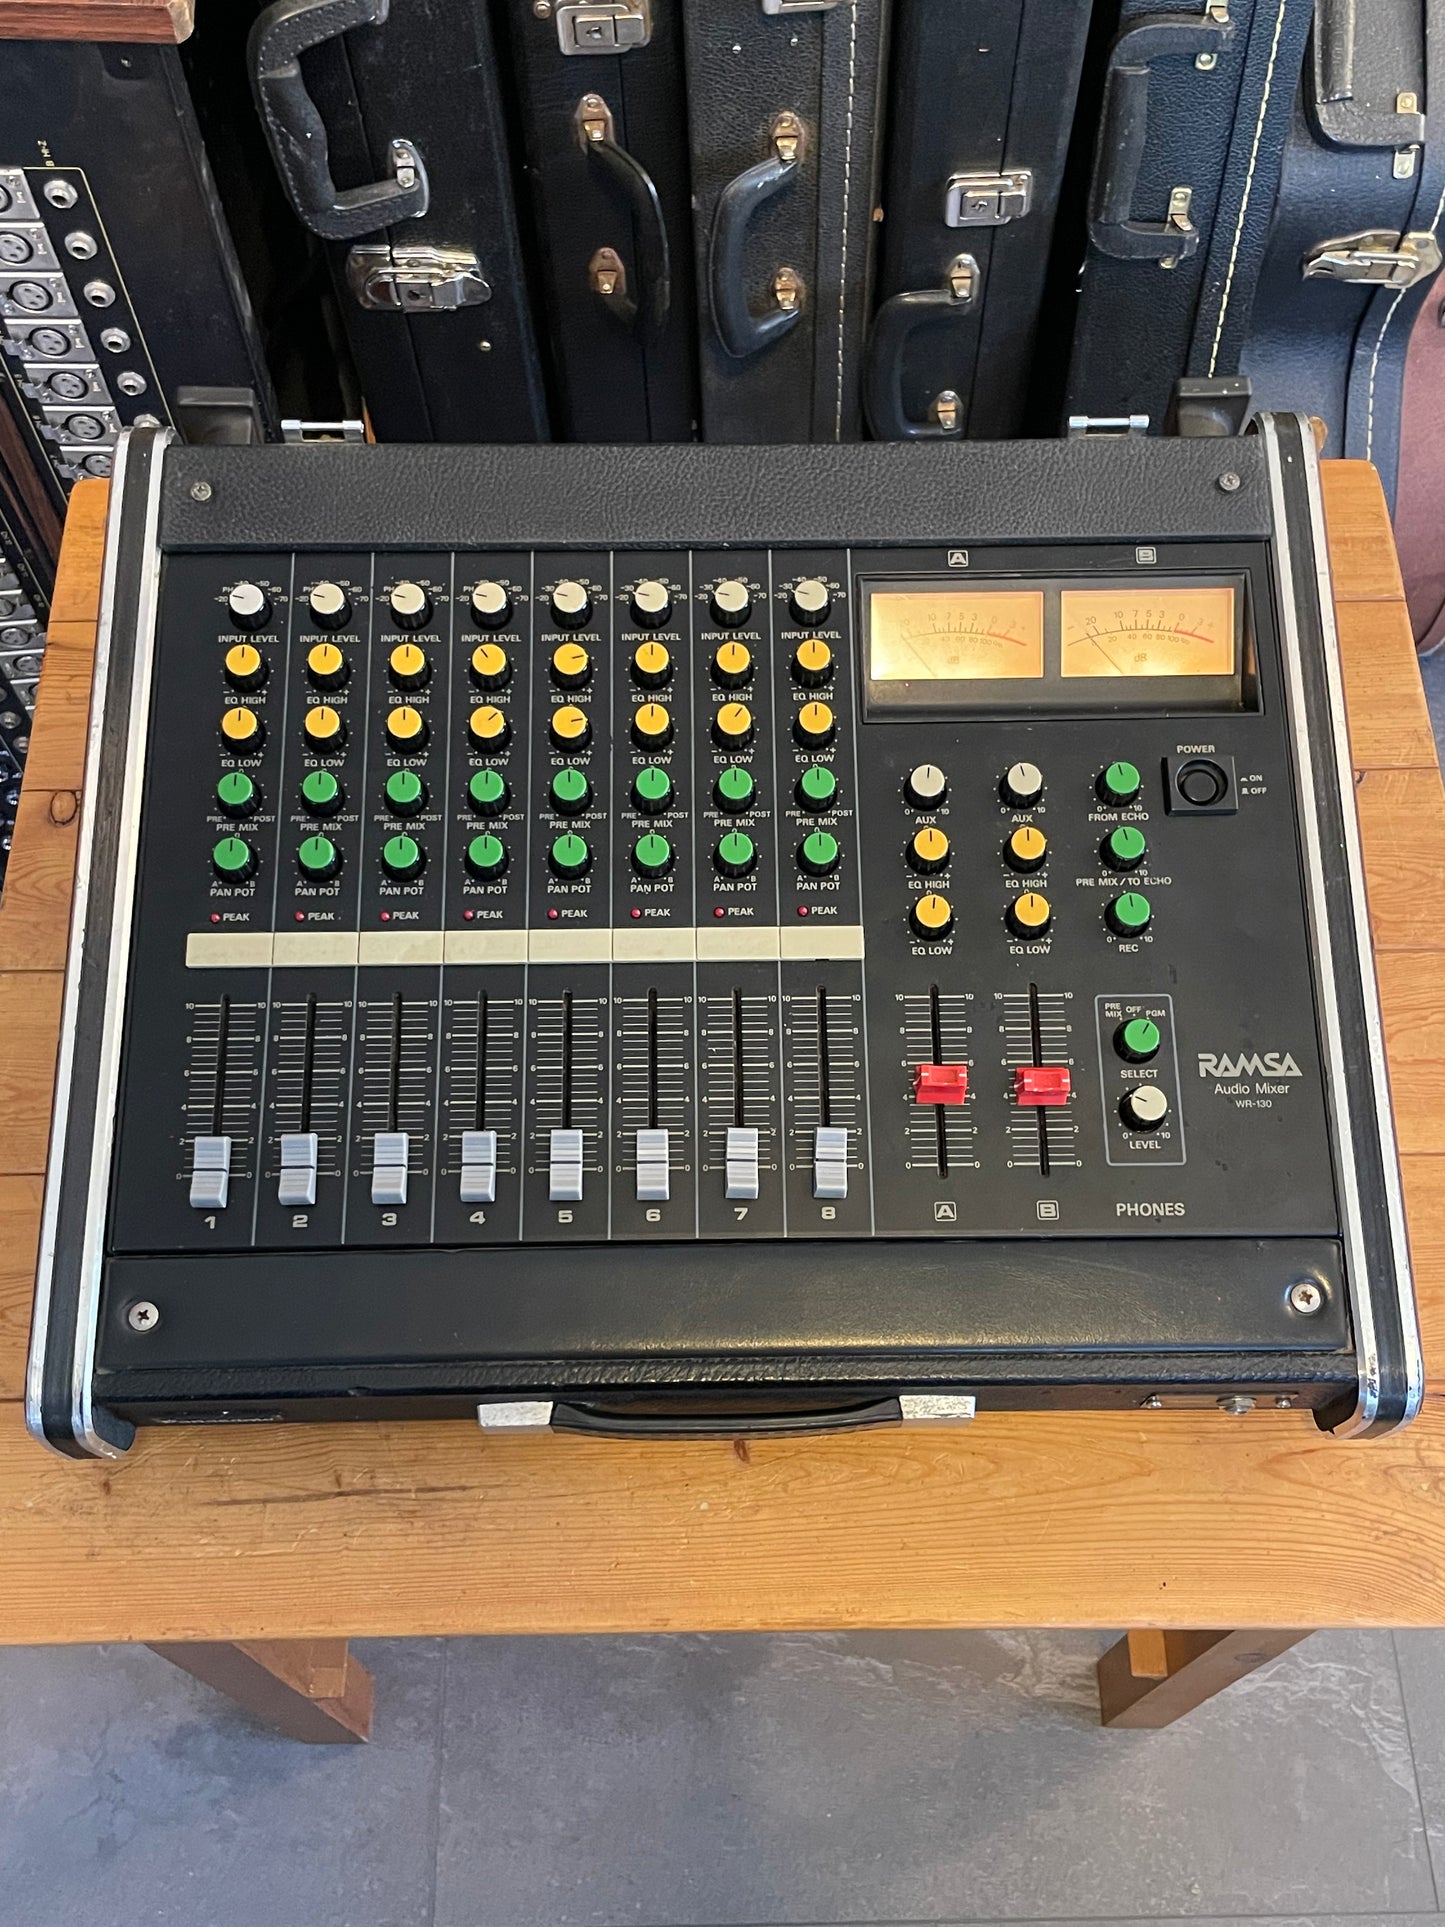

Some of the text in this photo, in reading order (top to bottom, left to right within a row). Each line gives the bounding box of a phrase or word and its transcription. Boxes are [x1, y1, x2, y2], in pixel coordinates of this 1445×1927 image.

[949, 551, 967, 566] A
[218, 635, 247, 643] INPUT
[493, 634, 521, 642] LEVEL
[622, 633, 681, 641] INPUT LEVEL
[701, 632, 761, 640] INPUT LEVEL
[813, 631, 841, 639] LEVEL
[307, 696, 347, 704] EQ HIGH
[389, 696, 429, 704] EQ HIGH
[551, 695, 564, 703] EQ
[809, 692, 833, 700] HIGH
[1177, 745, 1215, 753] POWER
[404, 758, 427, 766] LOW
[469, 758, 509, 766] EQ LOW
[567, 757, 590, 765] LOW
[648, 756, 672, 764] LOW
[730, 755, 753, 763] LOW
[795, 754, 834, 763] EQ LOW
[221, 759, 262, 767] EQ LOW
[304, 759, 344, 767] EQ LOW
[915, 816, 936, 824] AUX
[1011, 814, 1033, 822] AUX
[1088, 812, 1149, 821] FROM ECHO
[467, 822, 485, 830] PRE
[550, 821, 568, 829] PRE
[632, 820, 650, 828] PRE
[714, 819, 732, 827] PRE
[796, 818, 815, 826] PRE
[300, 823, 319, 831] PRE
[908, 881, 950, 889] EQ HIGH
[1006, 879, 1047, 888] EQ HIGH
[1076, 878, 1095, 886] PRE
[1144, 877, 1172, 885] ECHO
[463, 886, 507, 894] PAN POT
[547, 885, 591, 893] PAN POT
[630, 884, 674, 893] PAN POT
[713, 883, 757, 891] PAN POT
[797, 882, 840, 890] PAN POT
[210, 888, 255, 897] PAN POT
[295, 888, 340, 896] PAN POT
[379, 887, 424, 895] PAN POT
[728, 907, 754, 915] PEAK
[811, 906, 837, 914] PEAK
[223, 913, 249, 921] PEAK
[308, 912, 334, 920] PEAK
[393, 912, 419, 920] PEAK
[912, 946, 952, 955] EQ LOW
[1010, 945, 1050, 954] EQ LOW
[1119, 944, 1138, 952] REC
[1198, 1052, 1303, 1077] RAMSA
[1121, 1069, 1158, 1078] SELECT
[1214, 1082, 1290, 1094] Audio Mixer
[1235, 1100, 1272, 1108] WR-130
[1129, 1140, 1161, 1149] LEVEL
[822, 1207, 835, 1219] 8
[936, 1202, 955, 1220] A
[1038, 1202, 1057, 1219] B
[1116, 1203, 1185, 1216] PHONES
[470, 1211, 485, 1224] 4
[559, 1210, 572, 1223] 5
[646, 1209, 660, 1221] 6
[734, 1208, 748, 1220] 7
[205, 1216, 215, 1229] 1
[293, 1215, 308, 1227] 2
[382, 1213, 397, 1226] 3
